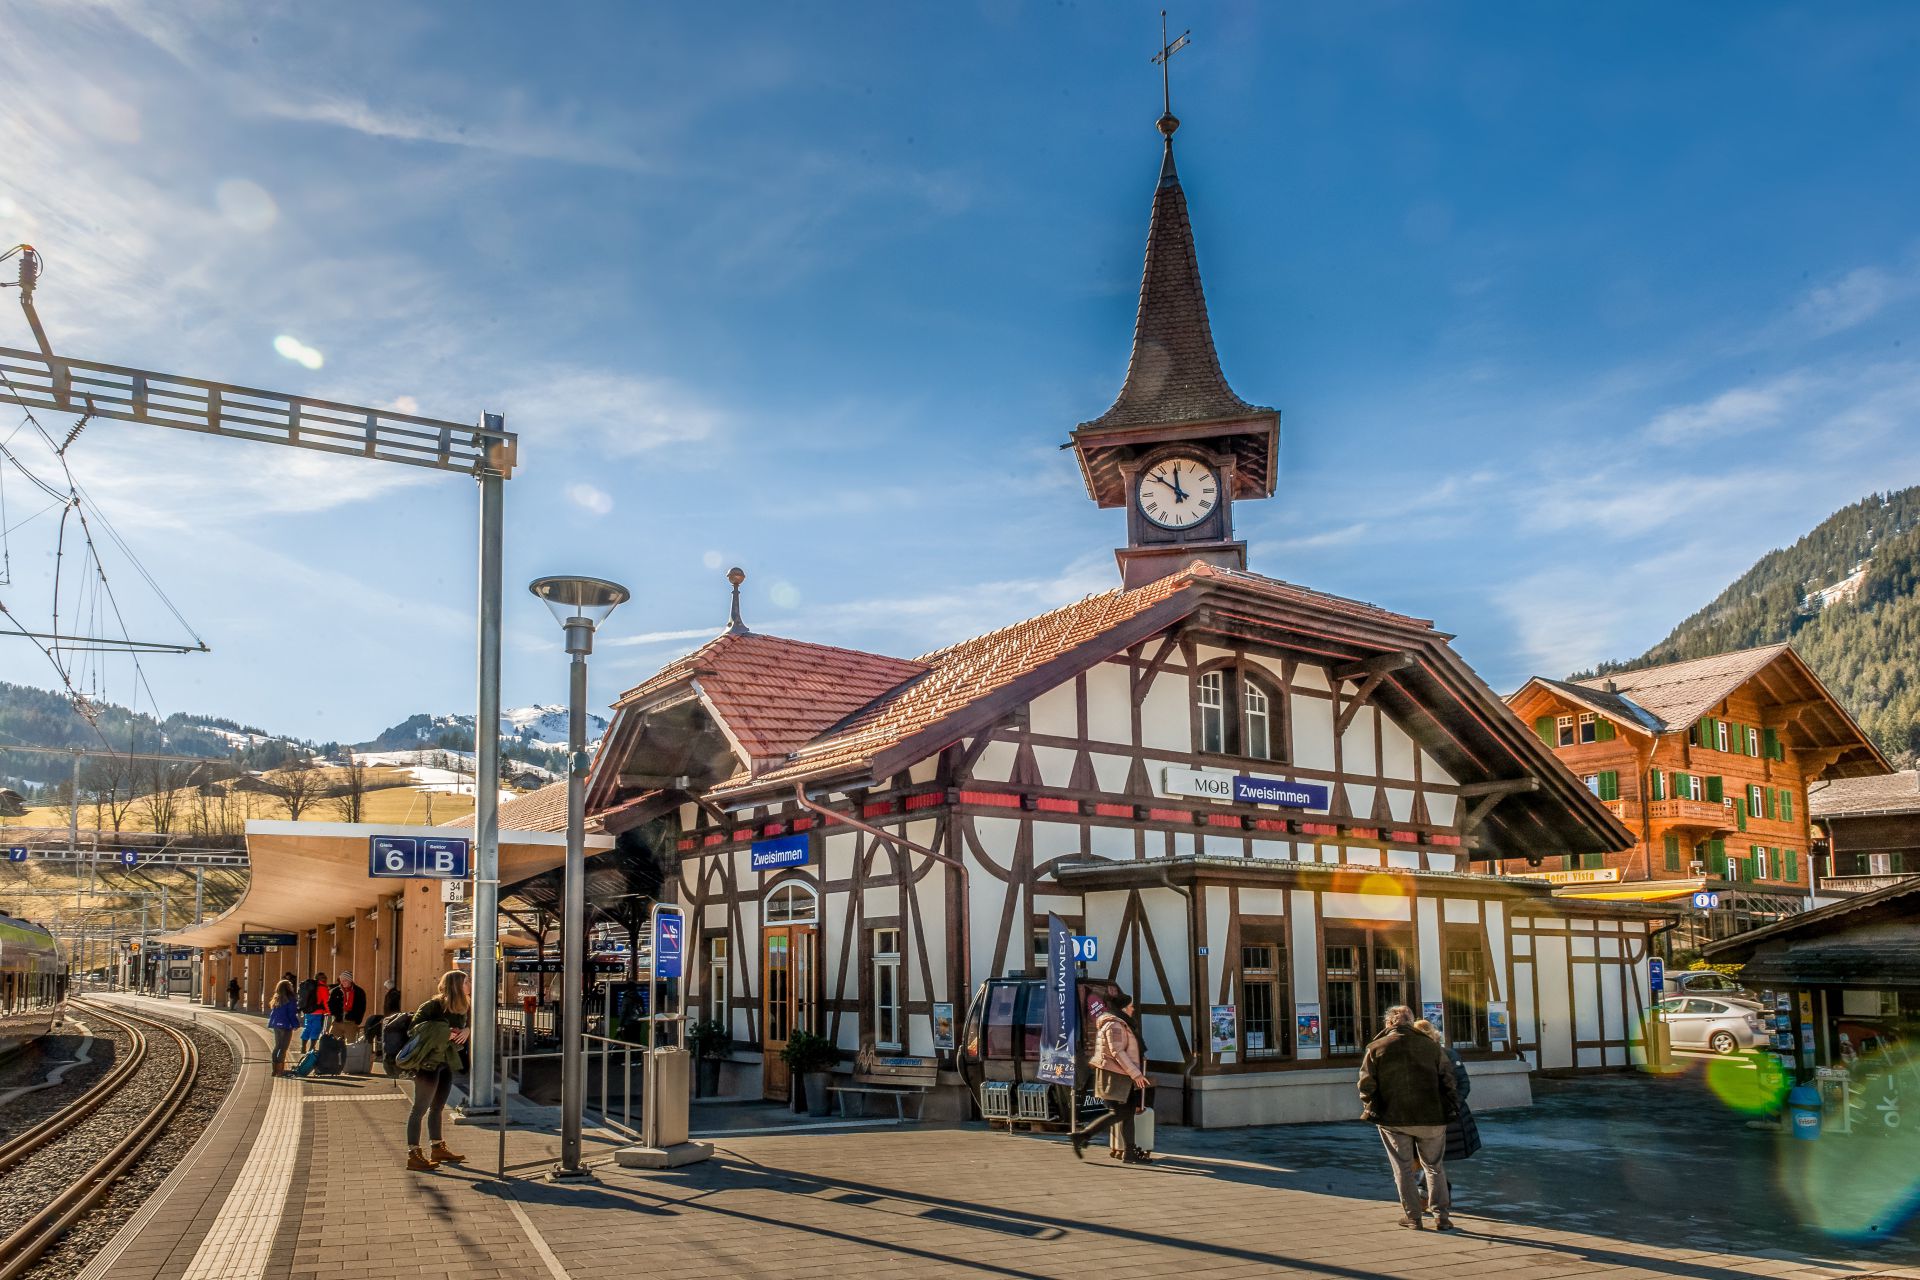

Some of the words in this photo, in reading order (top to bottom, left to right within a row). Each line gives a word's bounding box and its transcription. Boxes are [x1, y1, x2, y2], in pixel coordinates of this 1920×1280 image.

[1195, 778, 1229, 795] MOB
[1239, 784, 1310, 804] Zweisimmen
[14, 849, 23, 859] 7
[125, 852, 134, 862] 6
[385, 849, 404, 871] 6
[435, 851, 454, 872] B
[753, 849, 802, 866] Zweisimmen
[1573, 872, 1594, 881] Vista
[450, 881, 460, 891] 34
